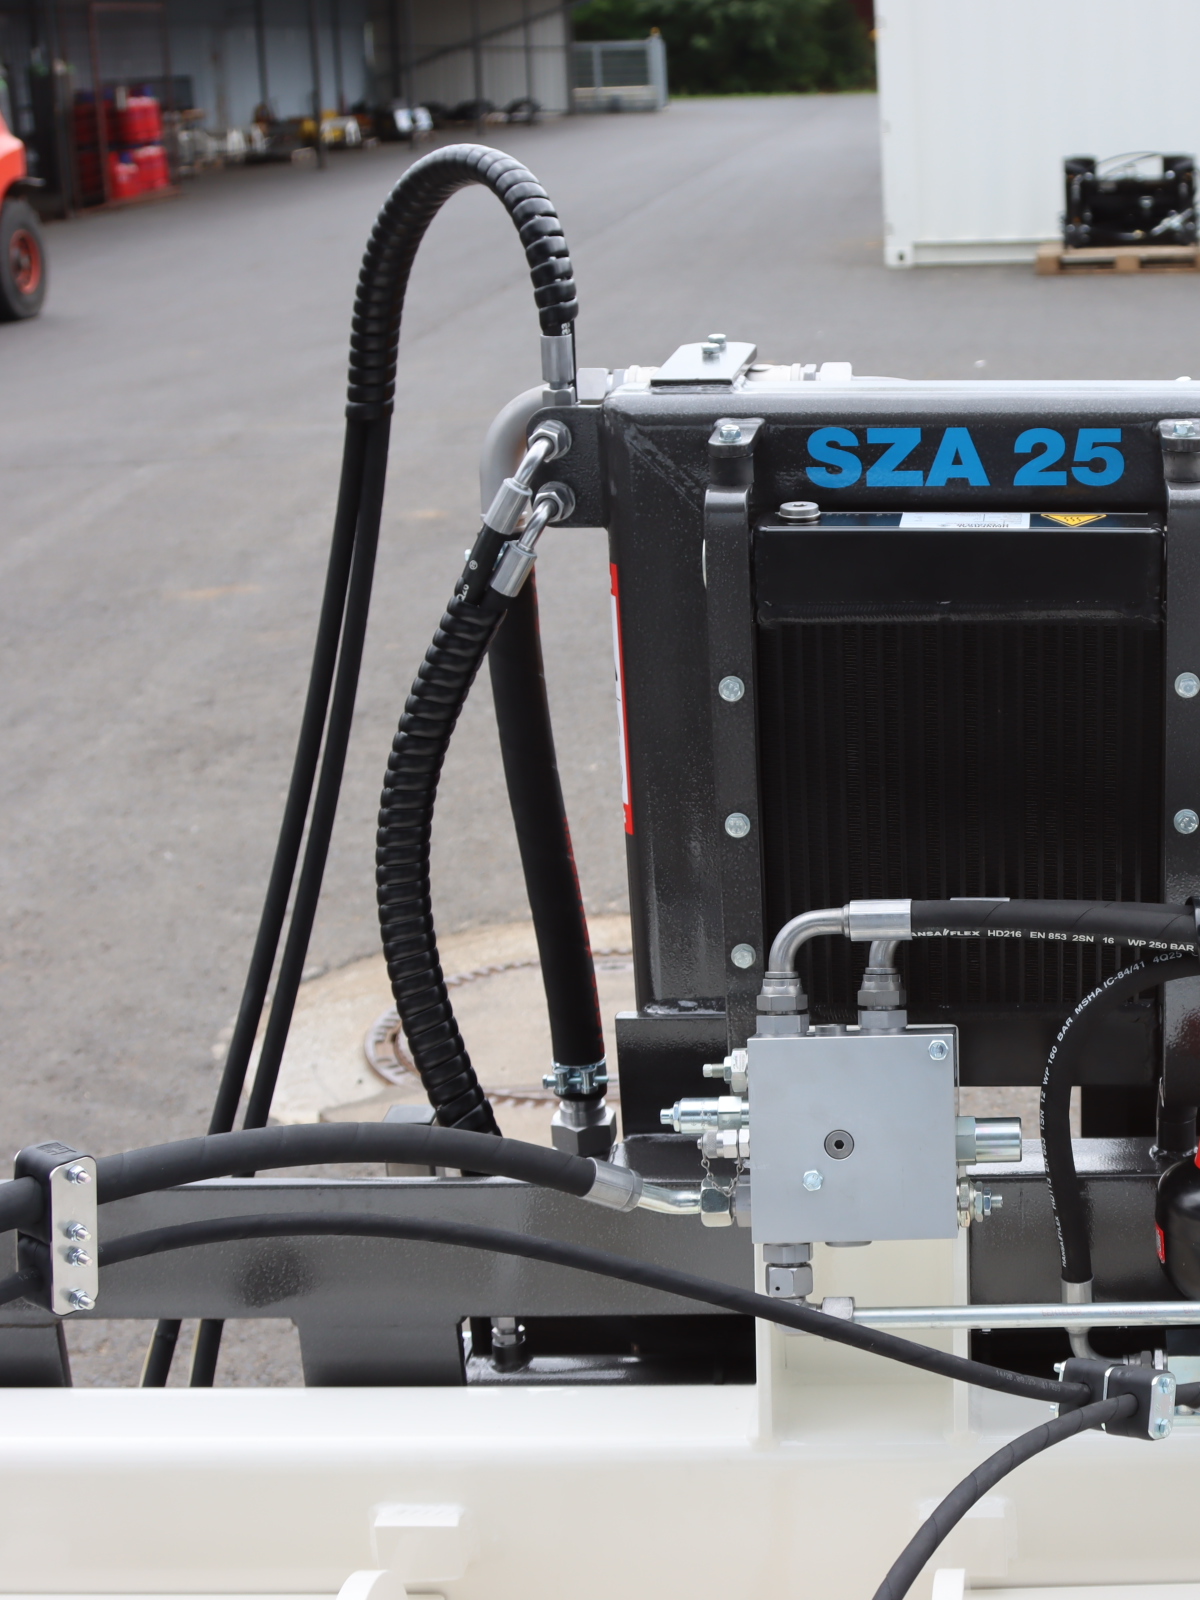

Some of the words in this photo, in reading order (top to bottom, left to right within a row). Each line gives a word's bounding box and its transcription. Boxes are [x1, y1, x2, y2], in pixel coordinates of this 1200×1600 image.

[805, 426, 990, 489] SZA
[1013, 426, 1125, 488] 25
[987, 929, 1022, 938] HD216
[1030, 931, 1046, 939] EN
[1048, 932, 1067, 941] 853
[1072, 934, 1094, 943] 2SN
[1127, 938, 1147, 947] WP
[1148, 941, 1168, 950] 250
[1170, 943, 1195, 952] BAR
[1152, 951, 1183, 964] 4Q25
[1103, 961, 1146, 989] IC-84/41
[1074, 987, 1103, 1015] MSHA
[1056, 1016, 1074, 1042] BAR
[1047, 1045, 1058, 1064] 160
[1042, 1066, 1050, 1085] WP
[1040, 1091, 1046, 1103] 12
